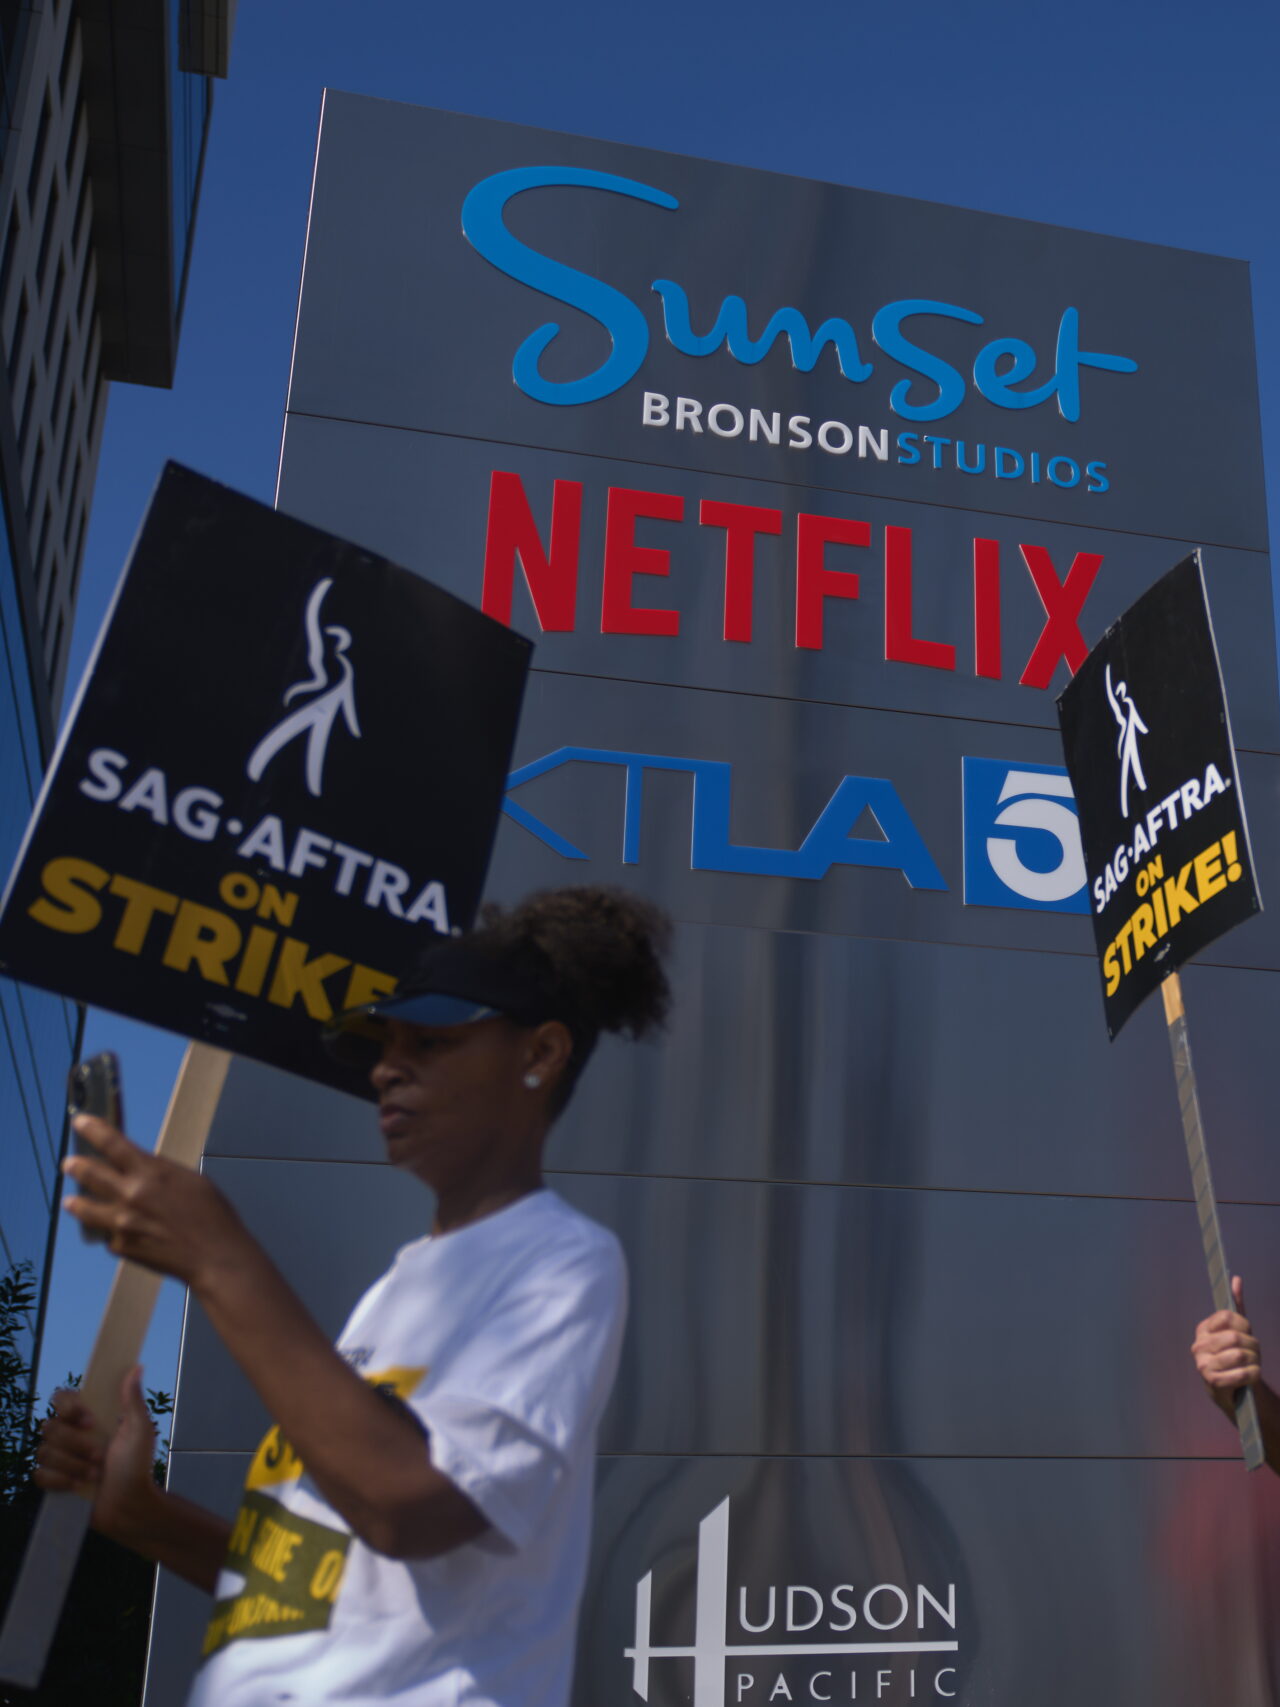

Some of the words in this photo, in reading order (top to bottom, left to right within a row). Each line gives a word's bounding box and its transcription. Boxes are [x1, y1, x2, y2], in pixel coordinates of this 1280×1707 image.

[481, 469, 1104, 691] NETFLIX
[503, 745, 950, 892] KTLA
[986, 769, 1088, 901] 5
[1136, 855, 1165, 898] ON
[219, 871, 299, 928] ON
[1102, 830, 1243, 998] STRIKE!
[737, 1667, 957, 1703] PACIFIC
